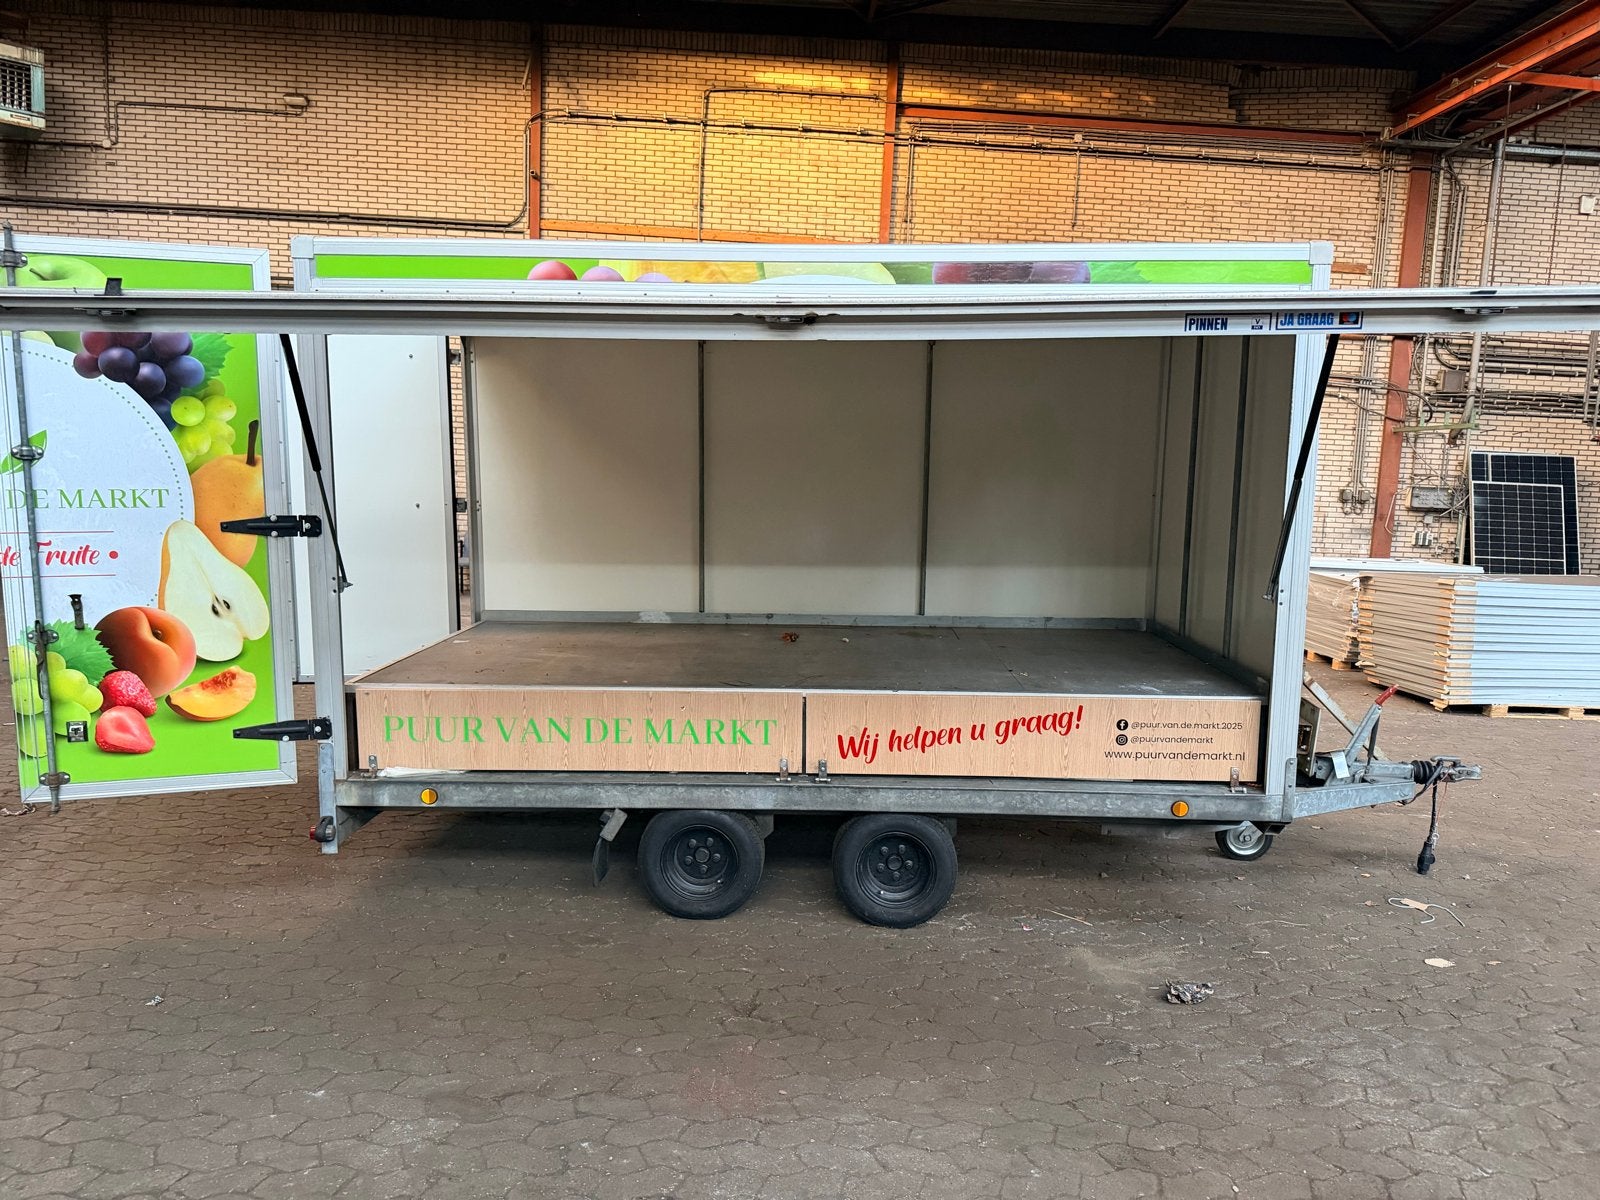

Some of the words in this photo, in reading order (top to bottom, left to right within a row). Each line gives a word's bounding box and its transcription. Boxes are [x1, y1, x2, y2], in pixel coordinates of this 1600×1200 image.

[1188, 317, 1228, 331] PINNEN
[1279, 313, 1294, 327] JA
[1297, 312, 1334, 326] GRAAG
[6, 488, 49, 509] DE
[57, 488, 170, 509] MARKT
[383, 715, 486, 744] PUUR
[494, 716, 574, 744] VAN
[584, 717, 633, 745] DE
[643, 718, 778, 746] MARKT
[1131, 720, 1243, 730] @puur.van.de.markt.2025
[837, 726, 880, 764] Wij
[888, 725, 962, 754] helpen
[970, 723, 986, 741] u
[994, 704, 1084, 745] graag!
[1130, 735, 1214, 744] @puurvandemarkt
[1104, 750, 1246, 761] www.puurvandemarkt.nl
